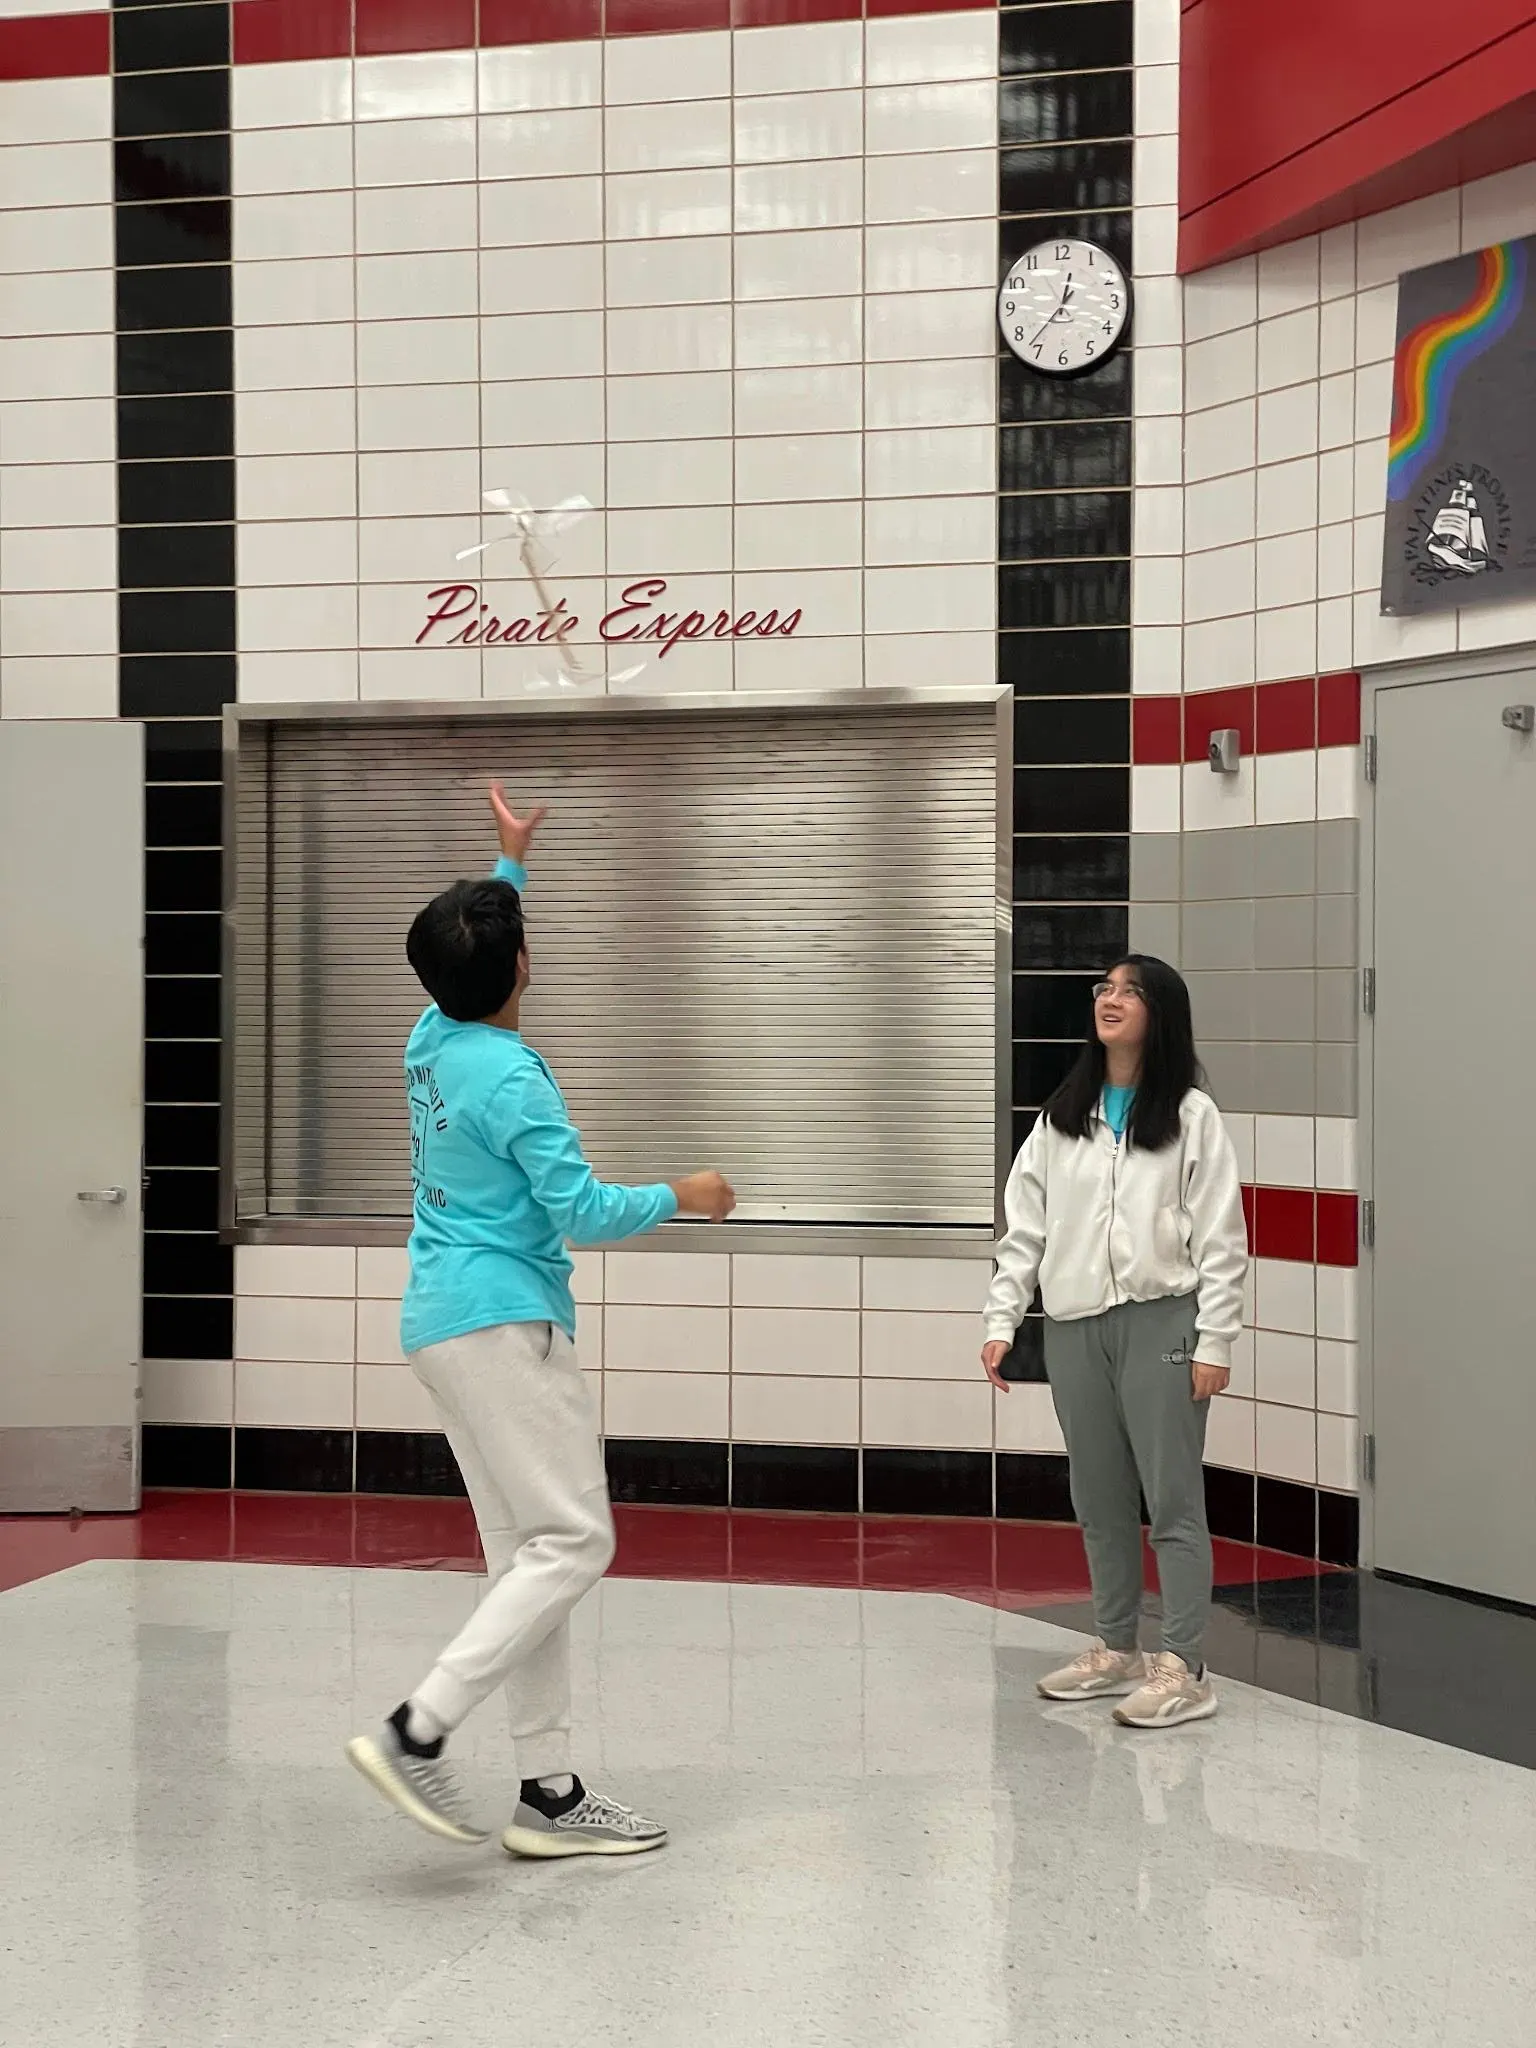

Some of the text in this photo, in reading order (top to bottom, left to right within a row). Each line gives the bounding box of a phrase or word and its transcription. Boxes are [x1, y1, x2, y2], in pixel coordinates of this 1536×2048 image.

[1055, 245, 1071, 260] 12
[1088, 251, 1095, 266] 1
[1027, 255, 1038, 270] 11
[1008, 277, 1025, 290] 10
[1103, 270, 1114, 285] 2
[1005, 301, 1016, 317] 9
[1110, 294, 1119, 309] 3
[1014, 326, 1024, 341] 8
[1102, 320, 1114, 335] 4
[1032, 344, 1043, 359] 7
[1085, 340, 1095, 356] 5
[1058, 350, 1068, 365] 6
[414, 579, 802, 659] Pirate Express
